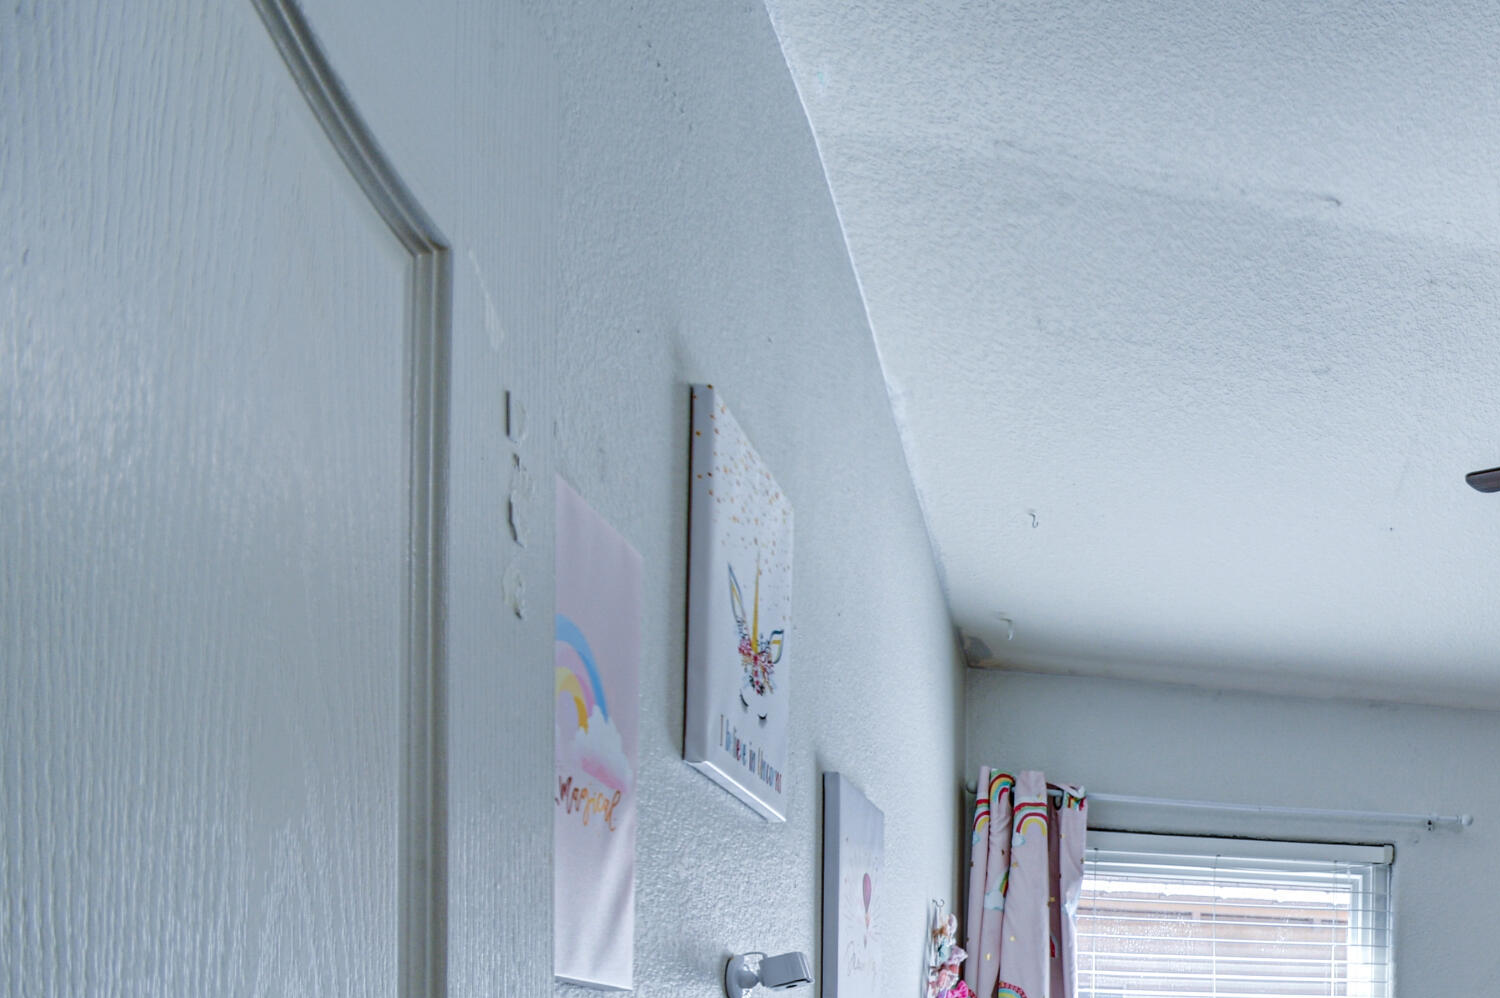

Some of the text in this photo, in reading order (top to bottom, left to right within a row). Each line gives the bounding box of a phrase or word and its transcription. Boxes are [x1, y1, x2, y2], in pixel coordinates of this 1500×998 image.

[725, 717, 746, 768] bliee
[757, 746, 782, 795] Uncons
[554, 775, 622, 832] Magical
